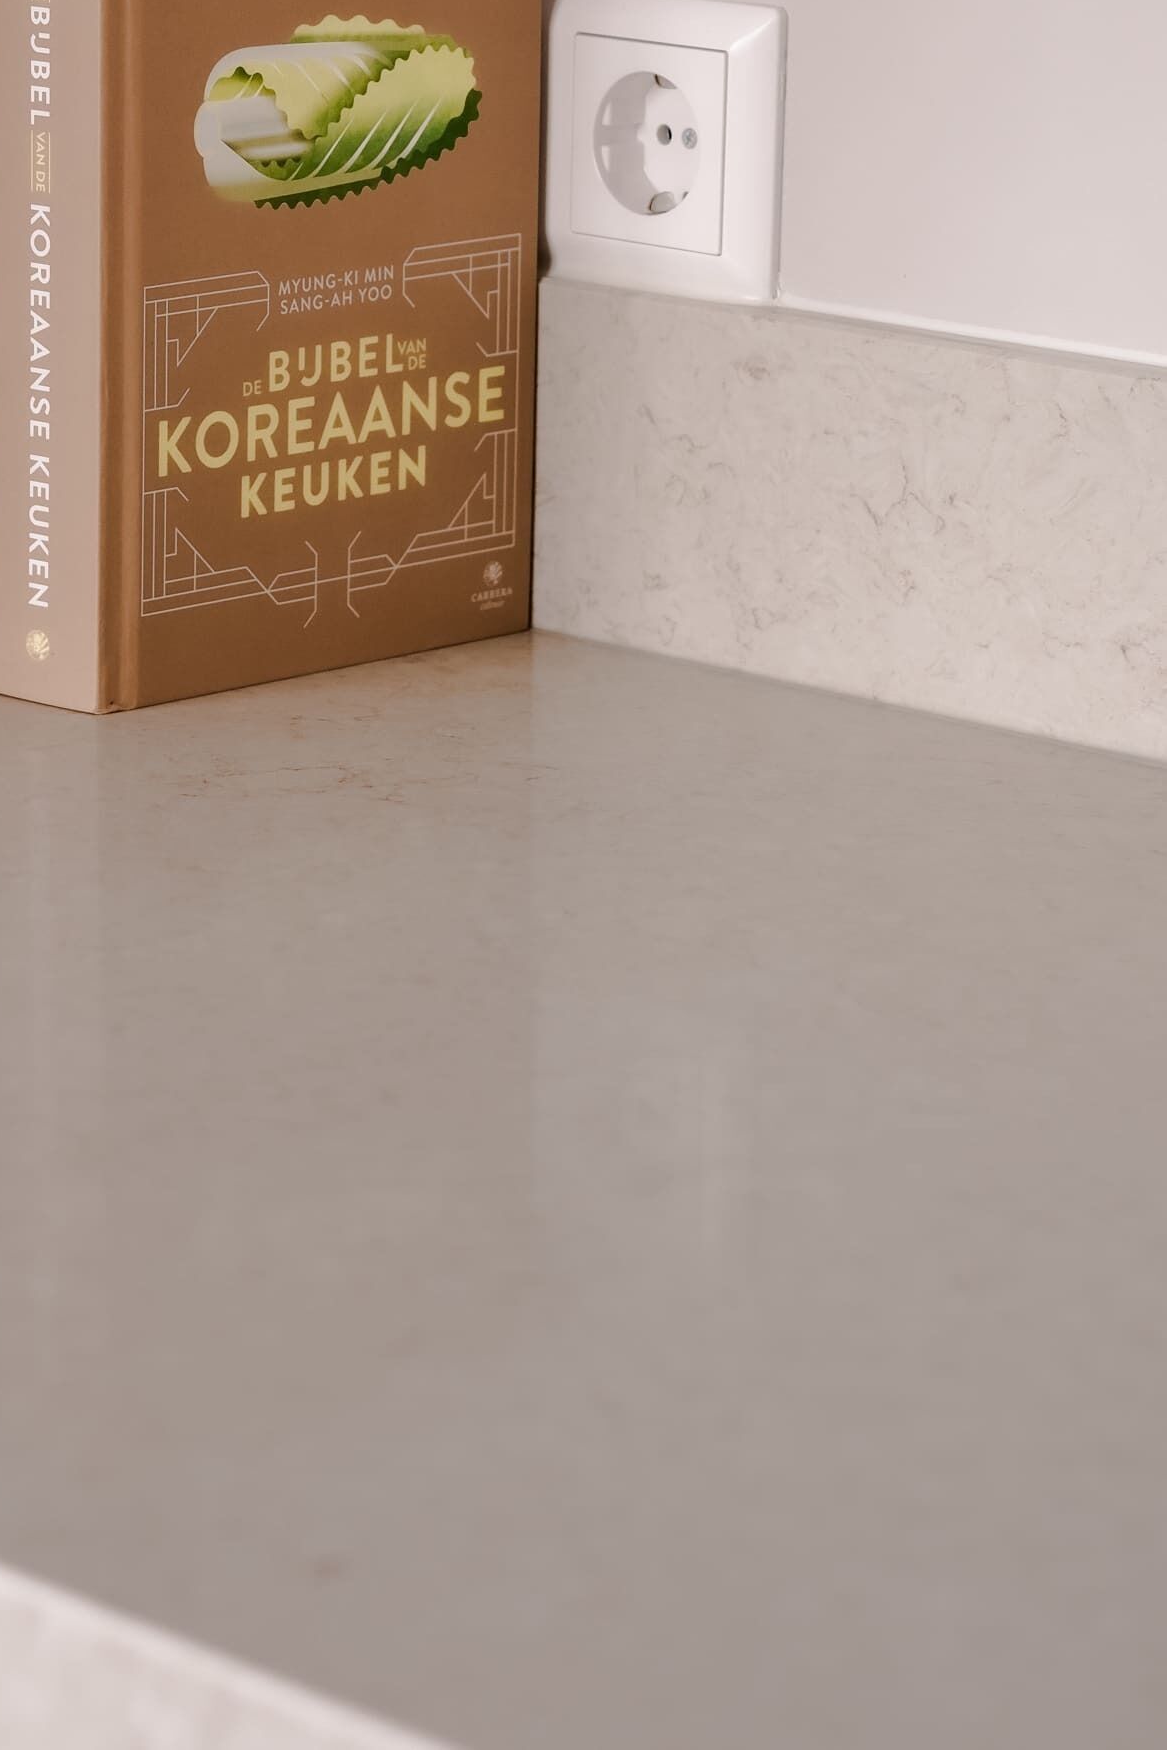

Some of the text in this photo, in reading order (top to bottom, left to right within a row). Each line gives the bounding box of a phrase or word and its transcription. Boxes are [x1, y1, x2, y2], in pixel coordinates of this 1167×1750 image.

[30, 6, 51, 126] BIJBEL
[36, 131, 46, 166] VAN
[36, 170, 46, 193] DE
[278, 265, 395, 296] MYUNG-KI MIN
[280, 284, 393, 315] SANG-AH YOO
[29, 203, 51, 441] KOREAANSE
[242, 333, 427, 397] DE BIJBEL VAN
[407, 354, 427, 371] DE
[157, 365, 506, 478] KOREAANSE
[240, 445, 427, 519] KEUKEN
[28, 453, 51, 608] KEUKEN
